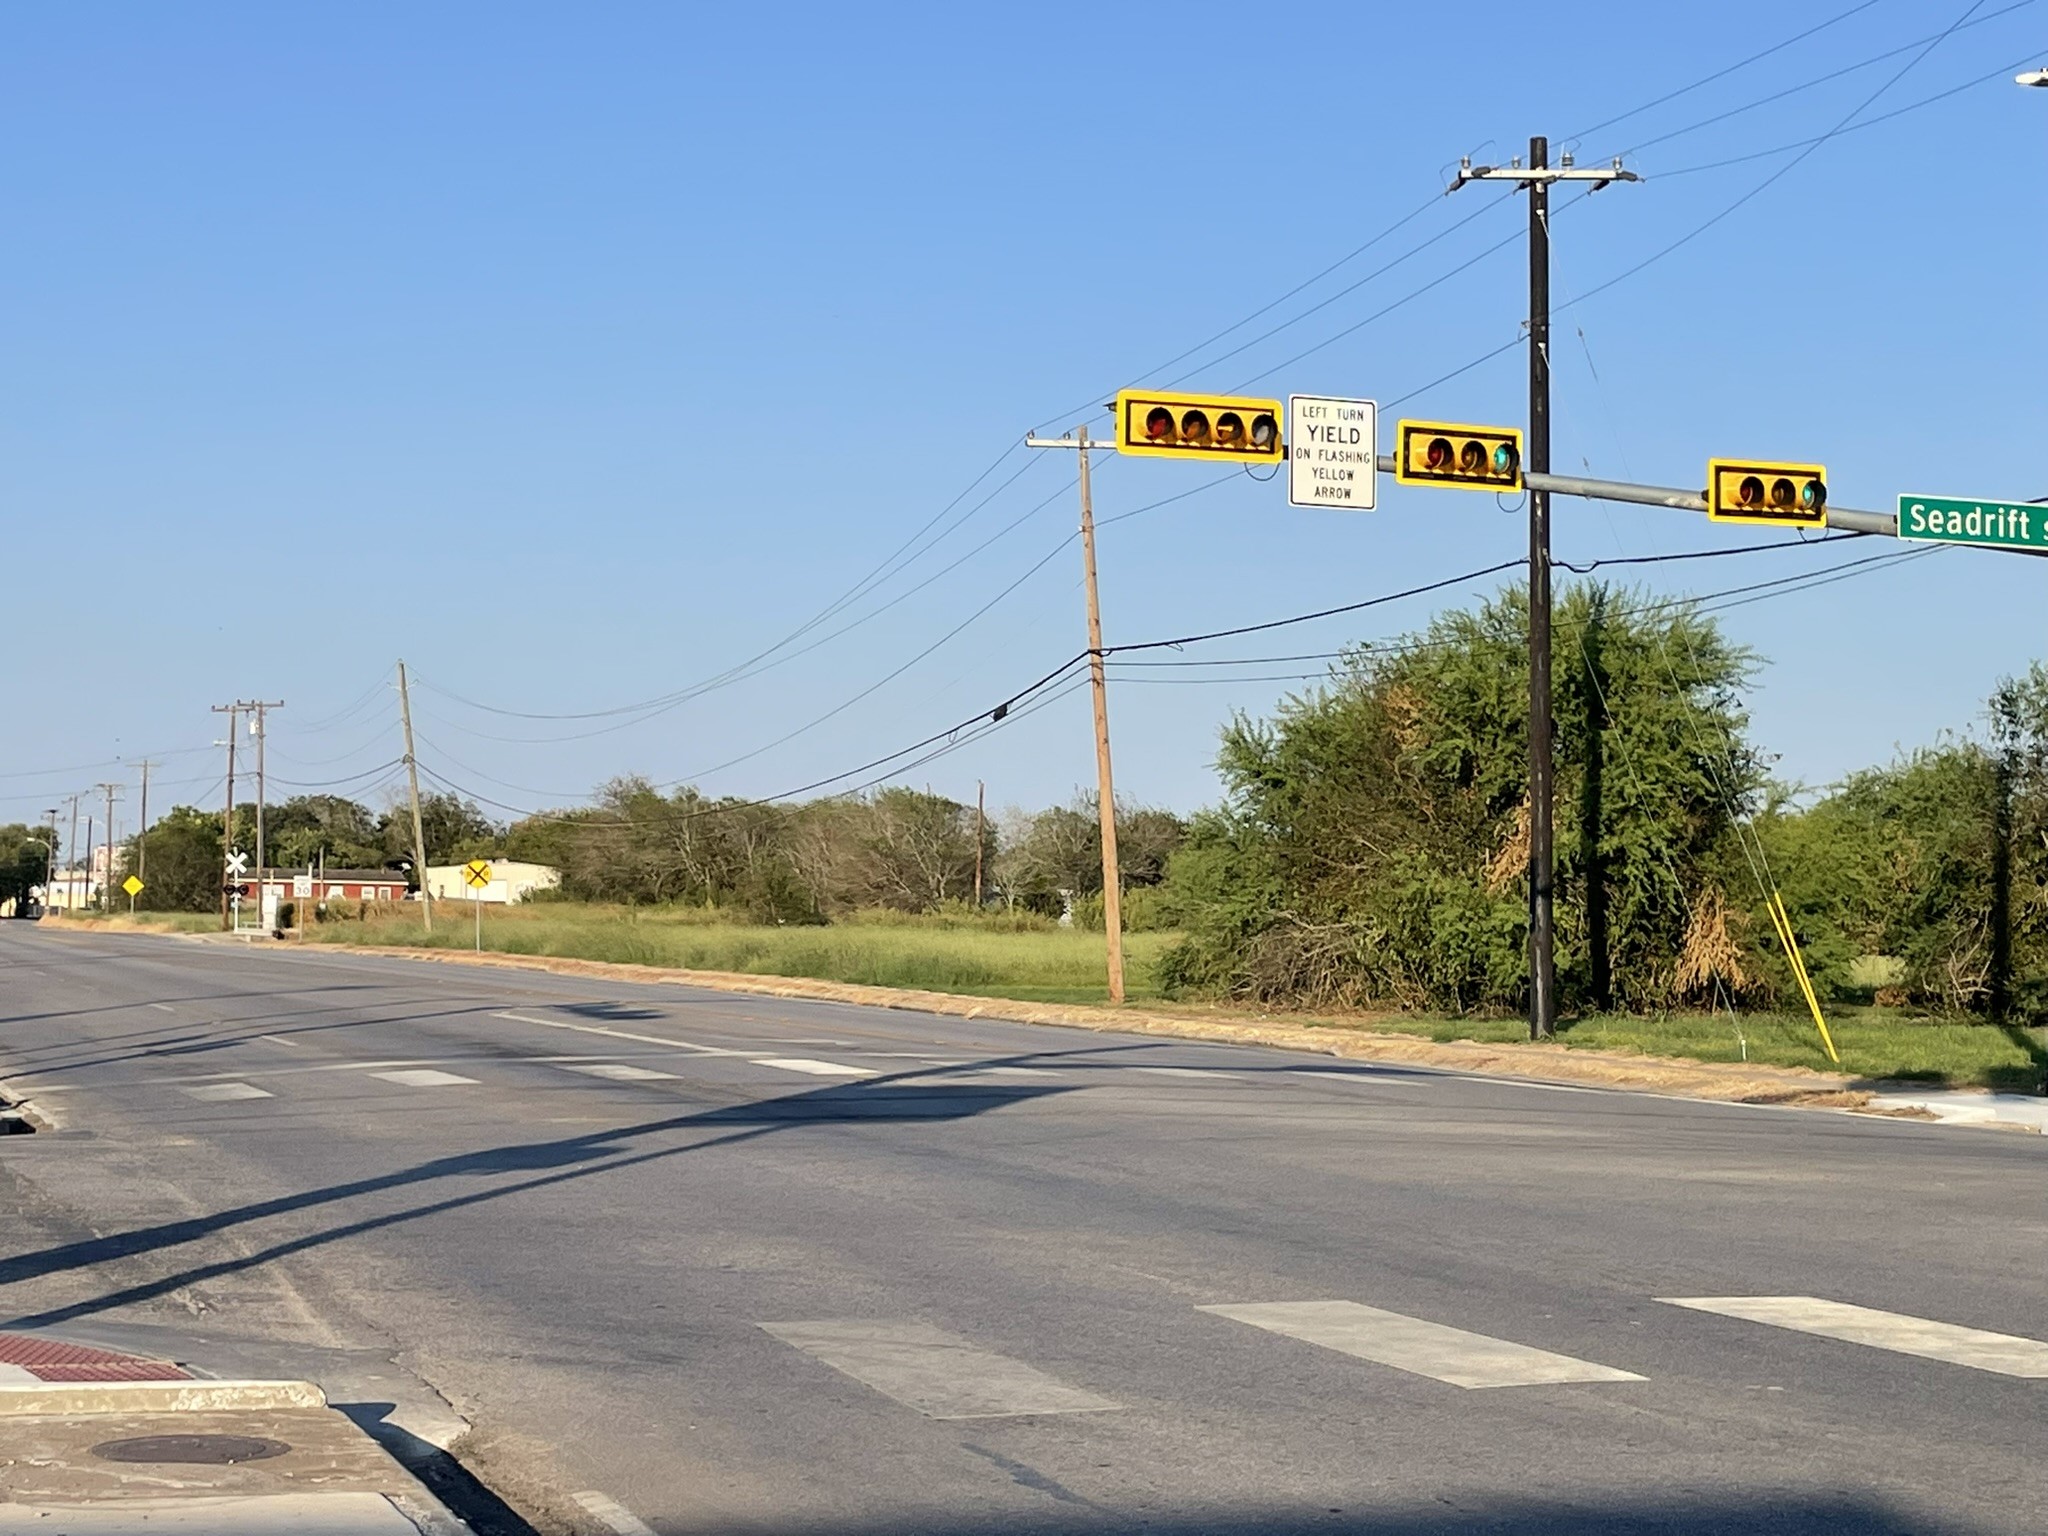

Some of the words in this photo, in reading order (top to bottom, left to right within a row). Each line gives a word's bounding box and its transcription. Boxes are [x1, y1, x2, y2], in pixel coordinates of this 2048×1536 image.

[1302, 405, 1328, 418] LEFT
[1336, 408, 1364, 421] TURN
[1306, 424, 1360, 444] YIELD
[1296, 447, 1311, 459] ON
[1318, 449, 1370, 464] FLASHING
[1312, 467, 1355, 481] YELLOW
[1314, 485, 1351, 499] ARROW
[1910, 504, 2030, 540] Seadrift
[296, 886, 310, 896] 30
